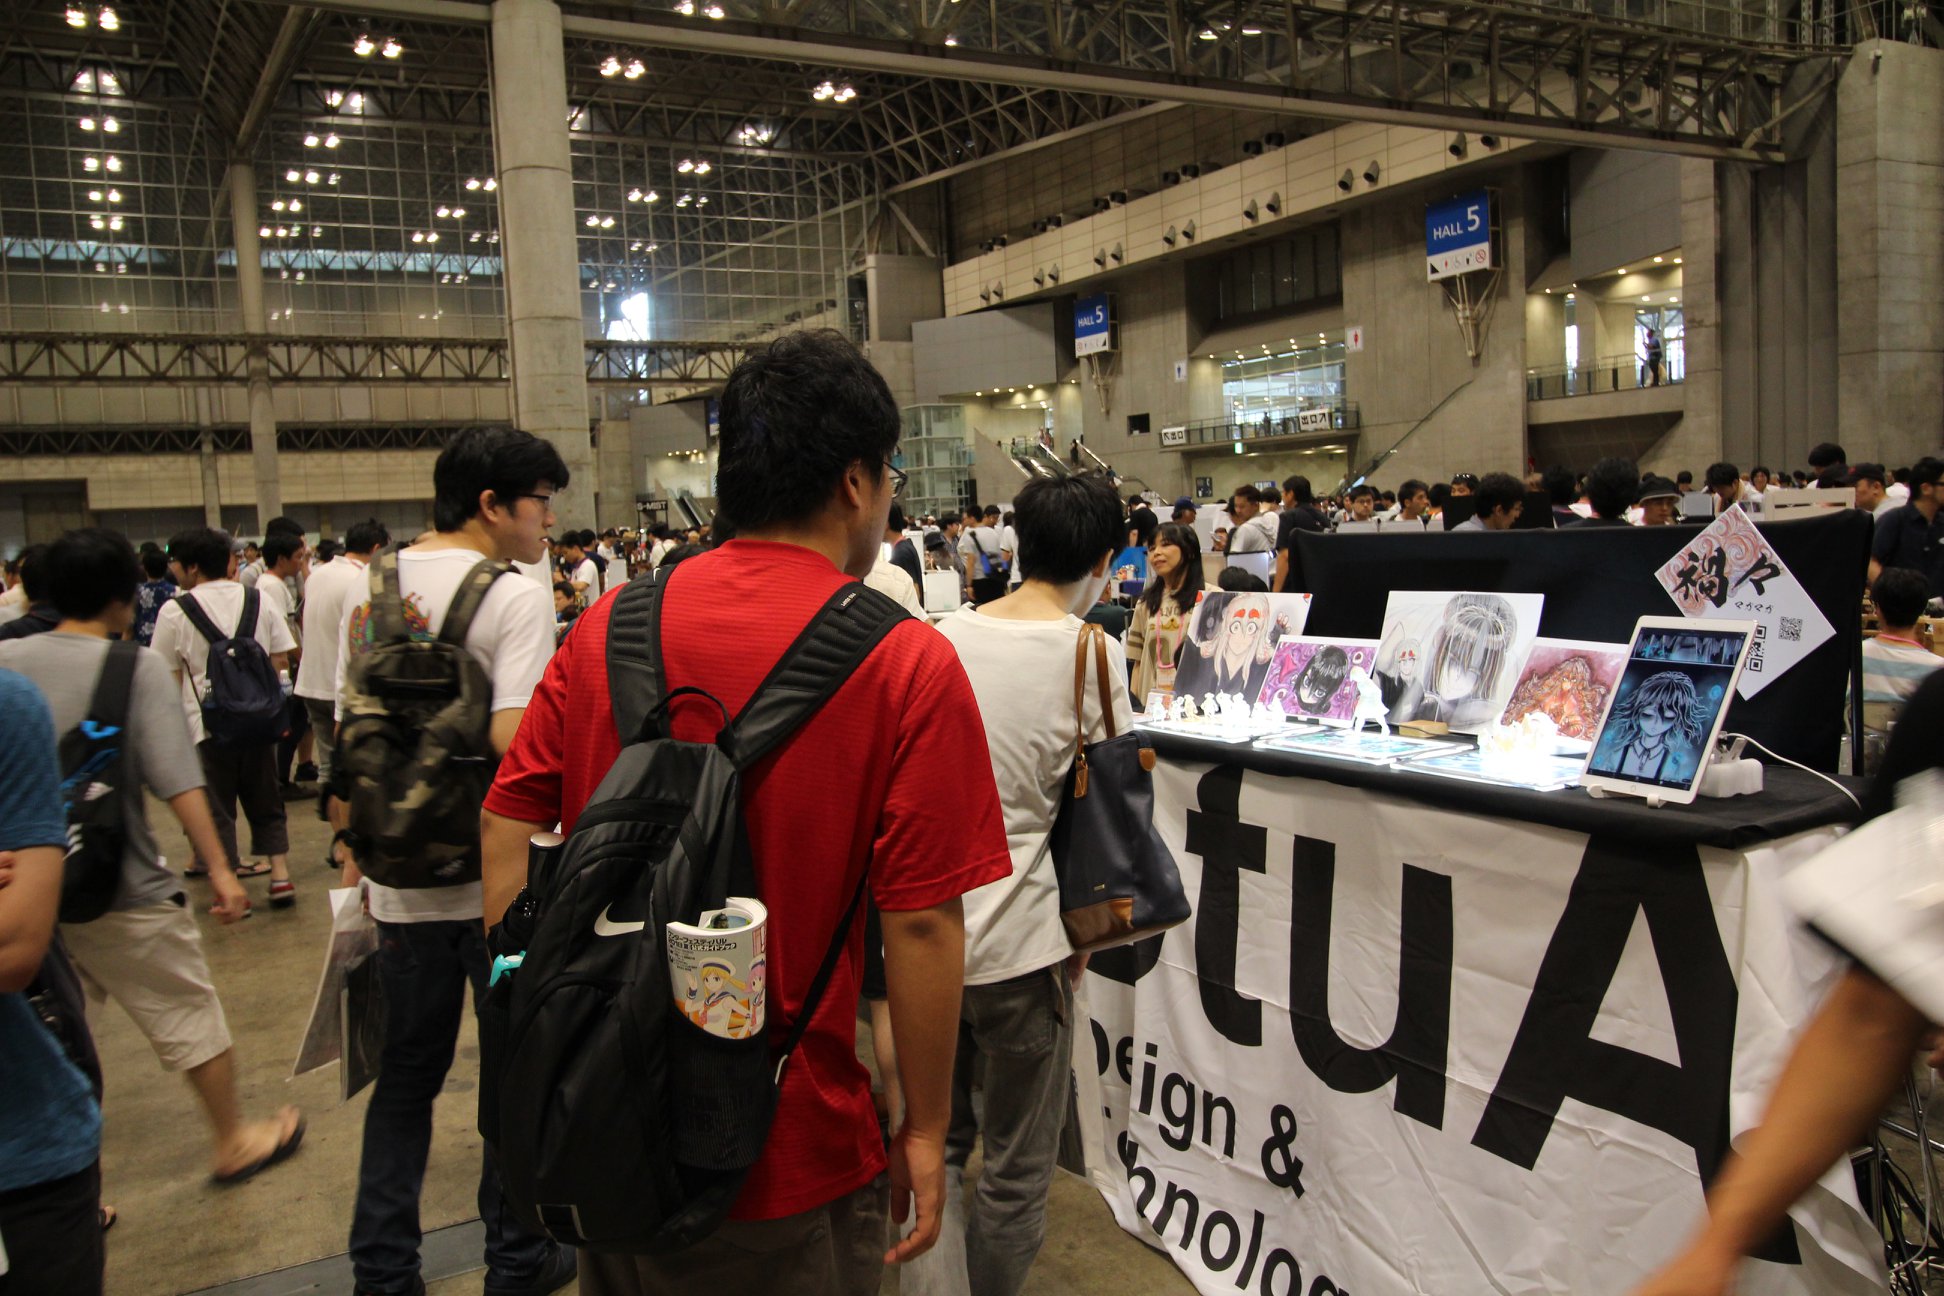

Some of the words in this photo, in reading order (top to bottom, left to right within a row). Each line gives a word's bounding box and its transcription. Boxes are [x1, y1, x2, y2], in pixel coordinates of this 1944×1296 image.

[1433, 221, 1463, 240] HALL
[1467, 205, 1480, 231] 5
[1078, 316, 1094, 328] HALL
[1096, 305, 1103, 323] 5
[1301, 414, 1317, 425] 出口
[1170, 431, 1183, 440] 出口
[1086, 768, 1803, 1266] tuA
[1261, 1104, 1305, 1199] &
